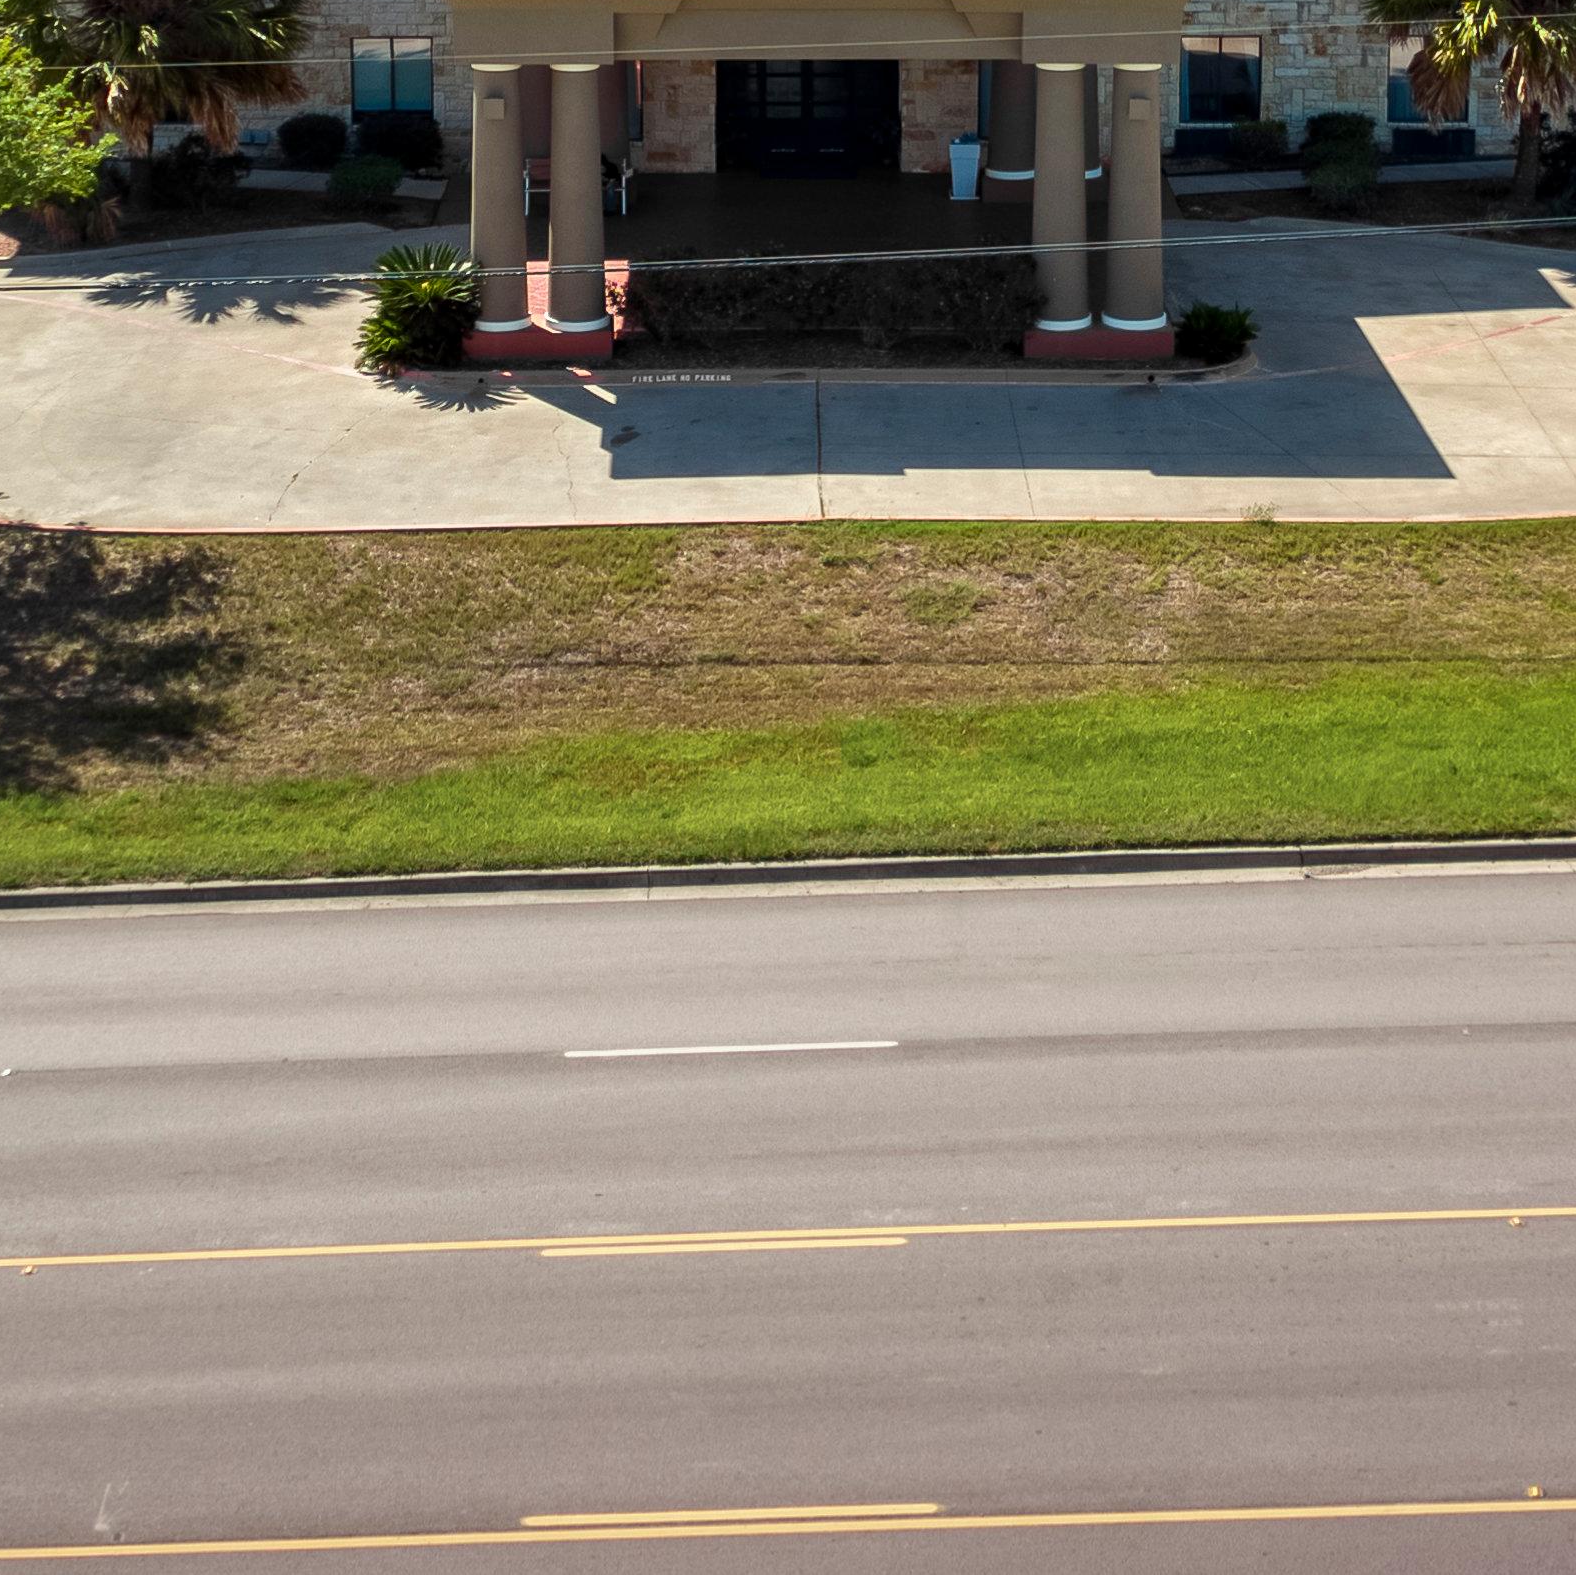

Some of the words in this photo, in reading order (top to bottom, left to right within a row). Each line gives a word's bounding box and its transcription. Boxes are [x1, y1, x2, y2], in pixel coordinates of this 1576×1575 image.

[632, 375, 654, 383] FIRE
[655, 374, 677, 382] LANE
[680, 374, 691, 382] NO
[694, 374, 732, 382] PARKING
